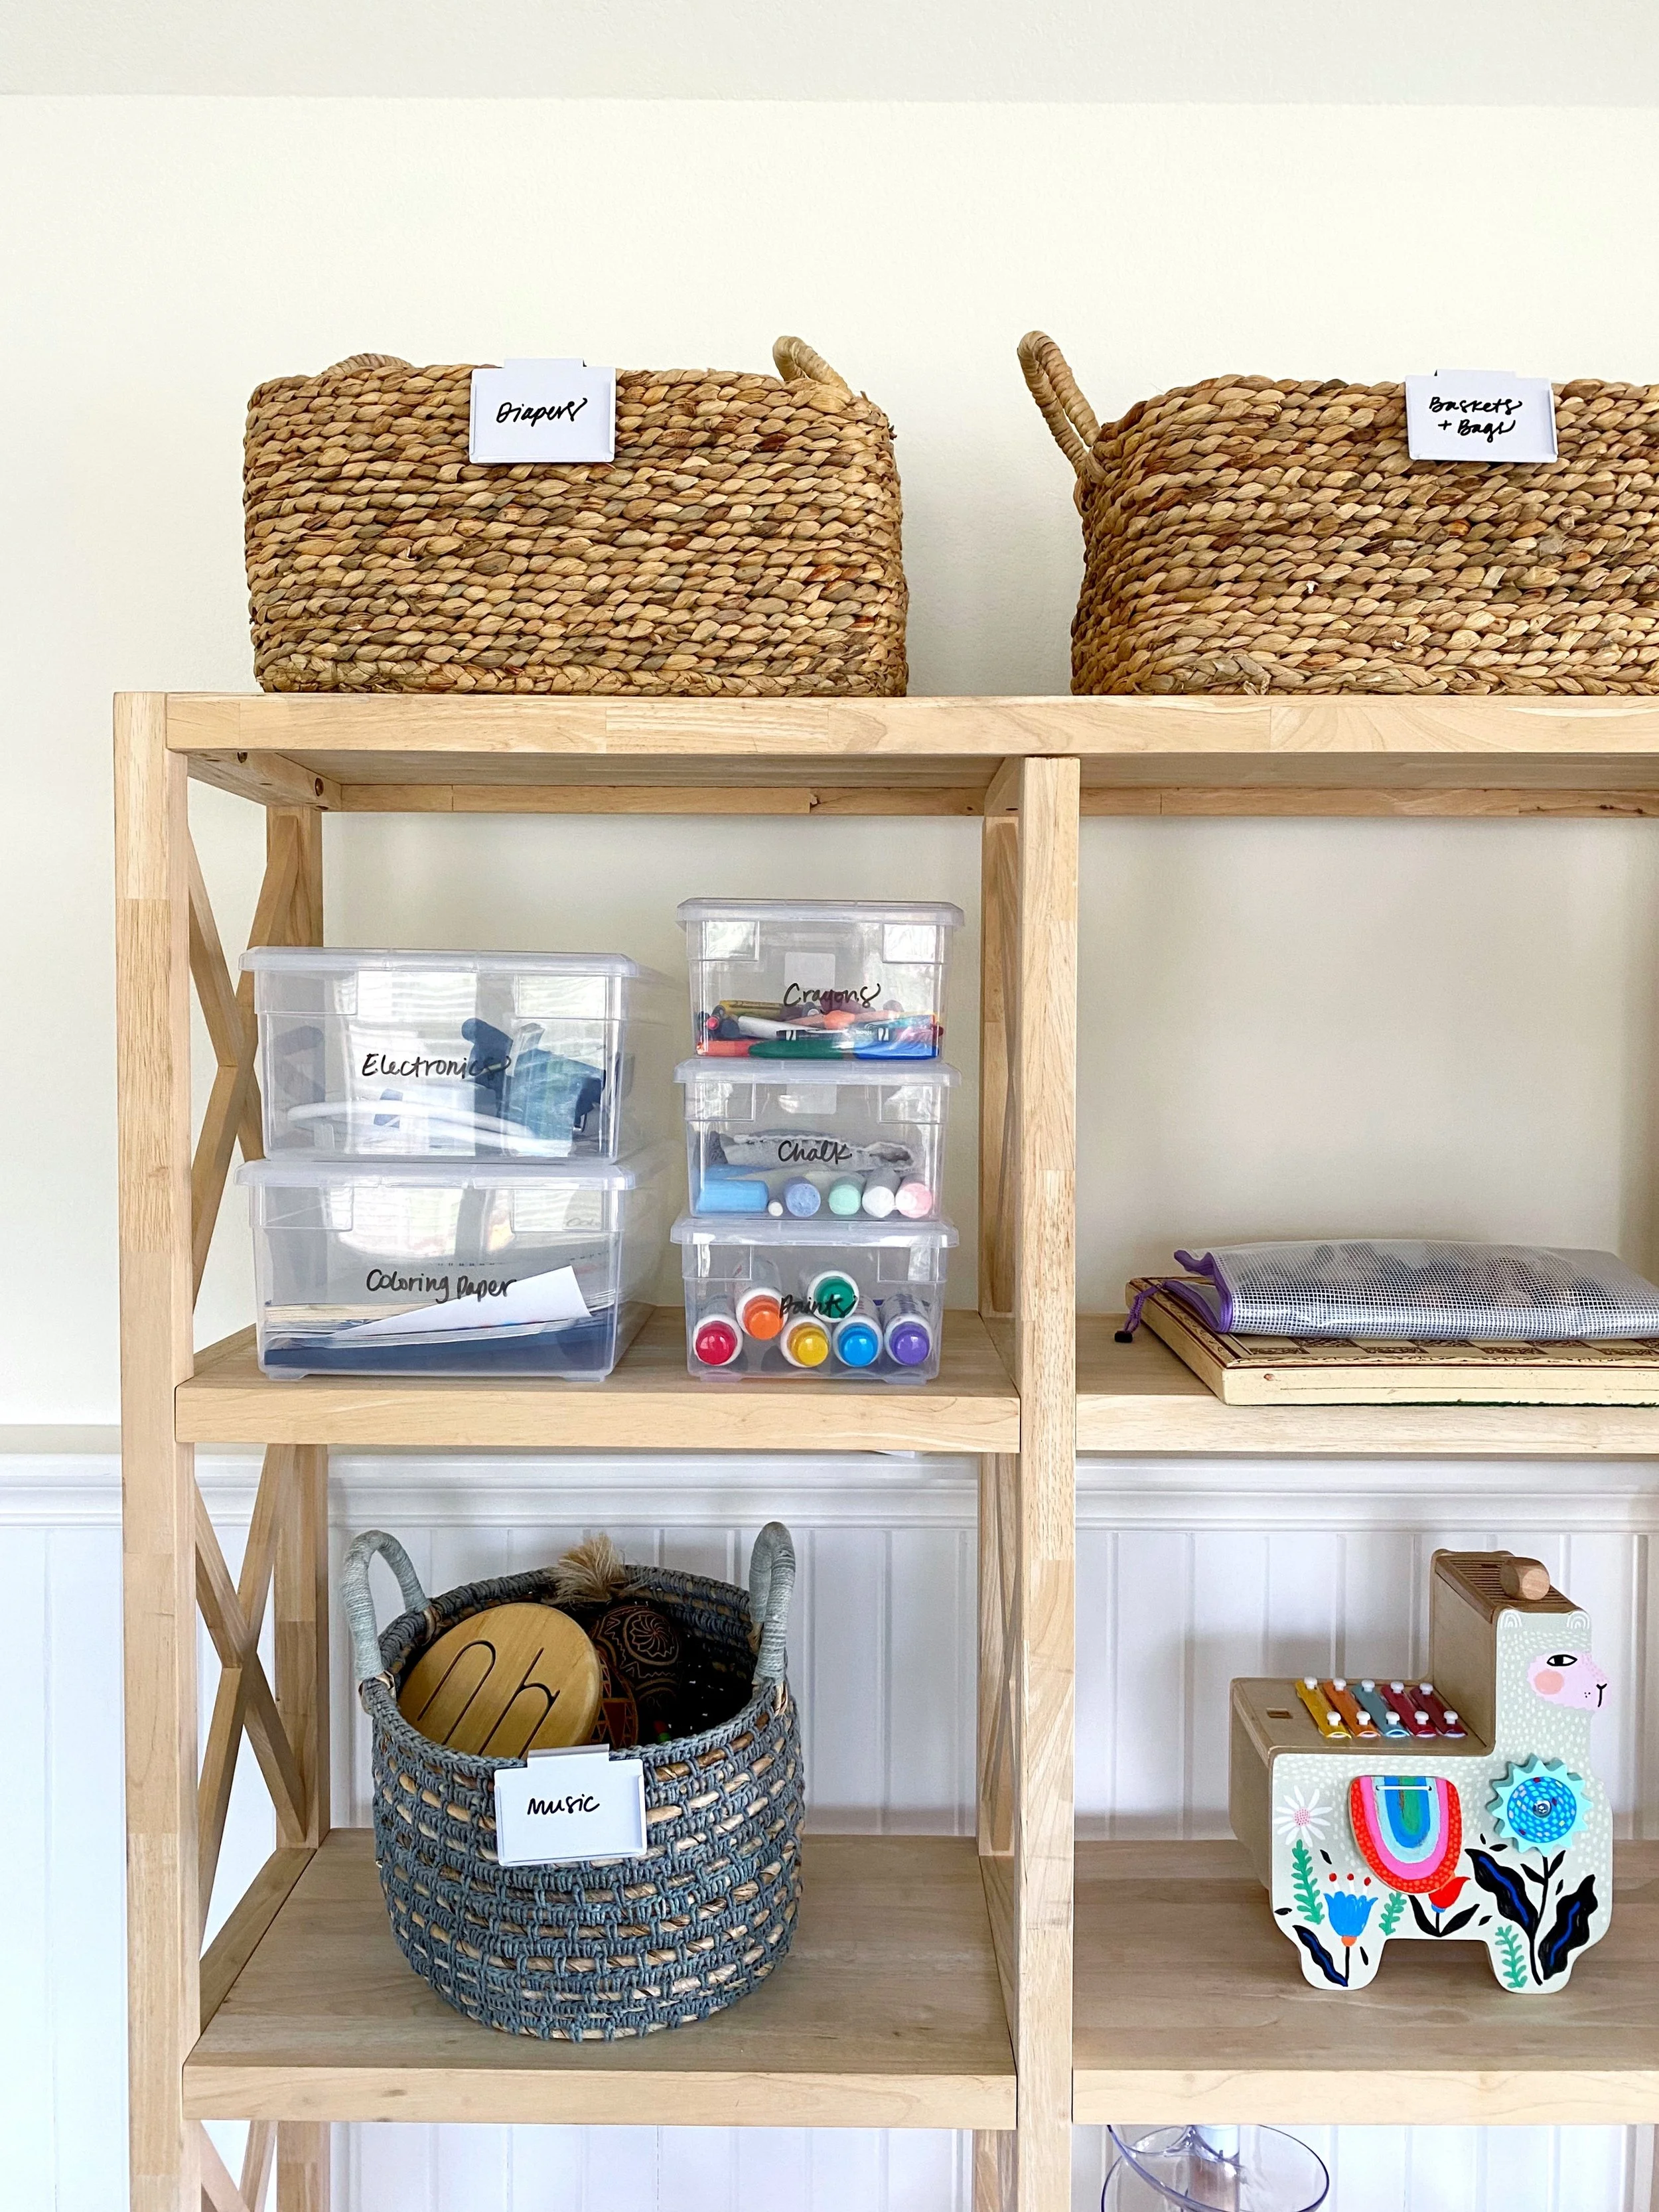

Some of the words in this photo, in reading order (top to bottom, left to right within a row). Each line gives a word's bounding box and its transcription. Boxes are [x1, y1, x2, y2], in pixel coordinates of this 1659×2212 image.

[496, 398, 588, 427] Diapers
[1429, 396, 1522, 415] Baskets
[1438, 420, 1452, 430] +
[1457, 419, 1516, 443] Bags
[784, 984, 881, 1007] Crayons
[362, 1053, 511, 1079] Electronics
[778, 1141, 852, 1164] Chalk
[367, 1268, 449, 1303] Coloring
[779, 1295, 857, 1318] Paints
